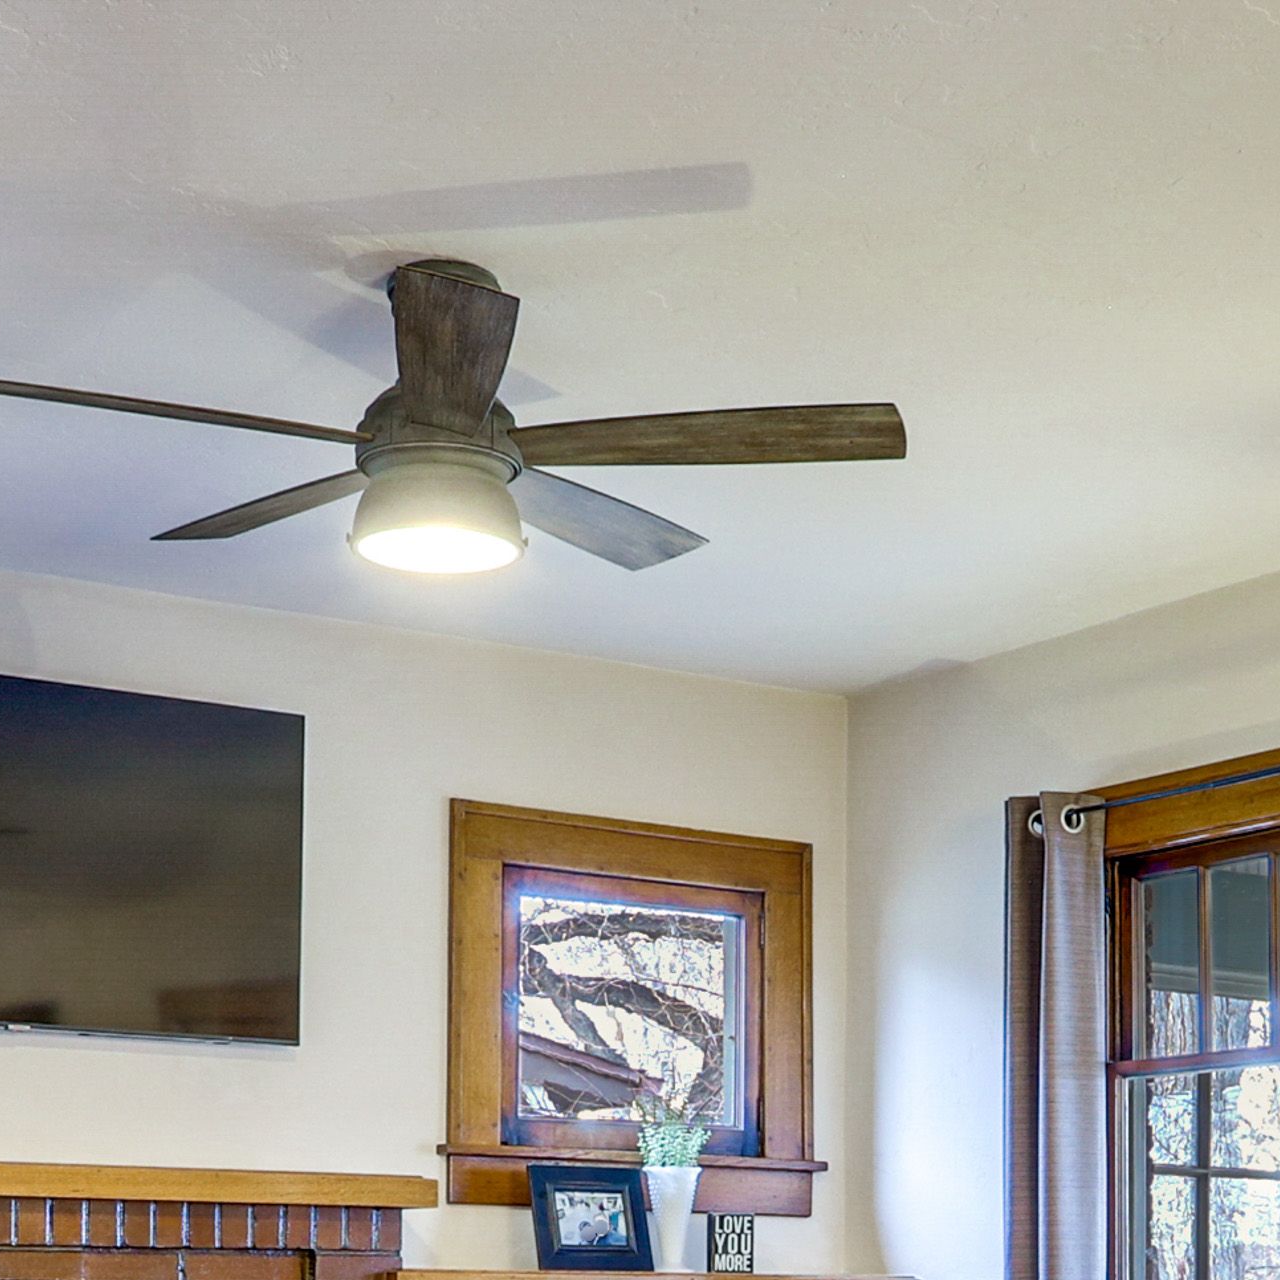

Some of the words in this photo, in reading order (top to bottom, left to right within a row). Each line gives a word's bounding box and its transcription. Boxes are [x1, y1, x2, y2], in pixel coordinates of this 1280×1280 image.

[715, 1215, 752, 1234] LOVE
[714, 1233, 751, 1254] YOU
[714, 1253, 751, 1272] MORE
